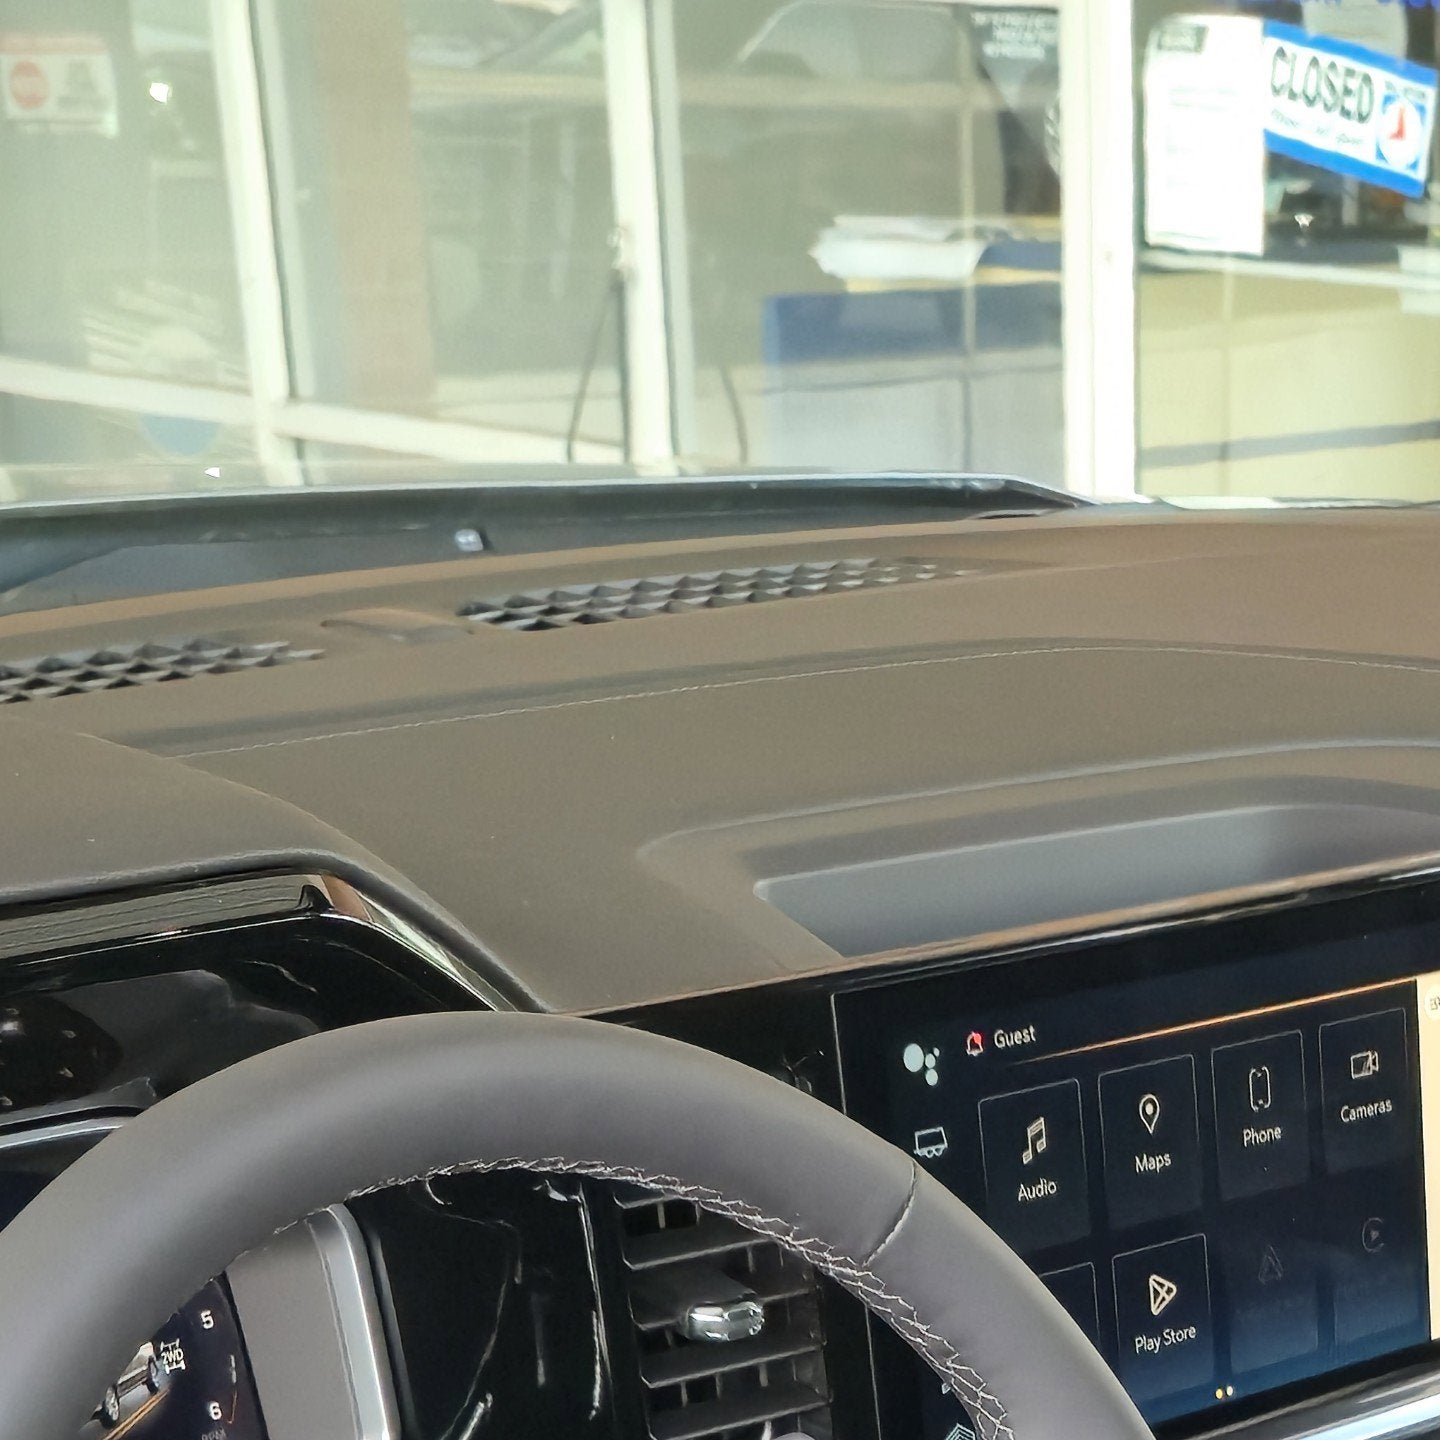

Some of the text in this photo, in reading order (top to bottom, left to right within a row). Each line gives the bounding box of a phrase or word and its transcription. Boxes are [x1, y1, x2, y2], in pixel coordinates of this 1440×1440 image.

[1271, 46, 1375, 124] CLOSED
[993, 1022, 1037, 1050] Guest
[1339, 1095, 1394, 1125] Cameras
[1242, 1121, 1283, 1147] Phone
[1134, 1148, 1173, 1175] Maps
[1016, 1177, 1058, 1203] Audio
[200, 1309, 215, 1330] 5
[1134, 1322, 1198, 1354] Play Store
[161, 1347, 185, 1368] 2WD
[208, 1401, 223, 1421] 6
